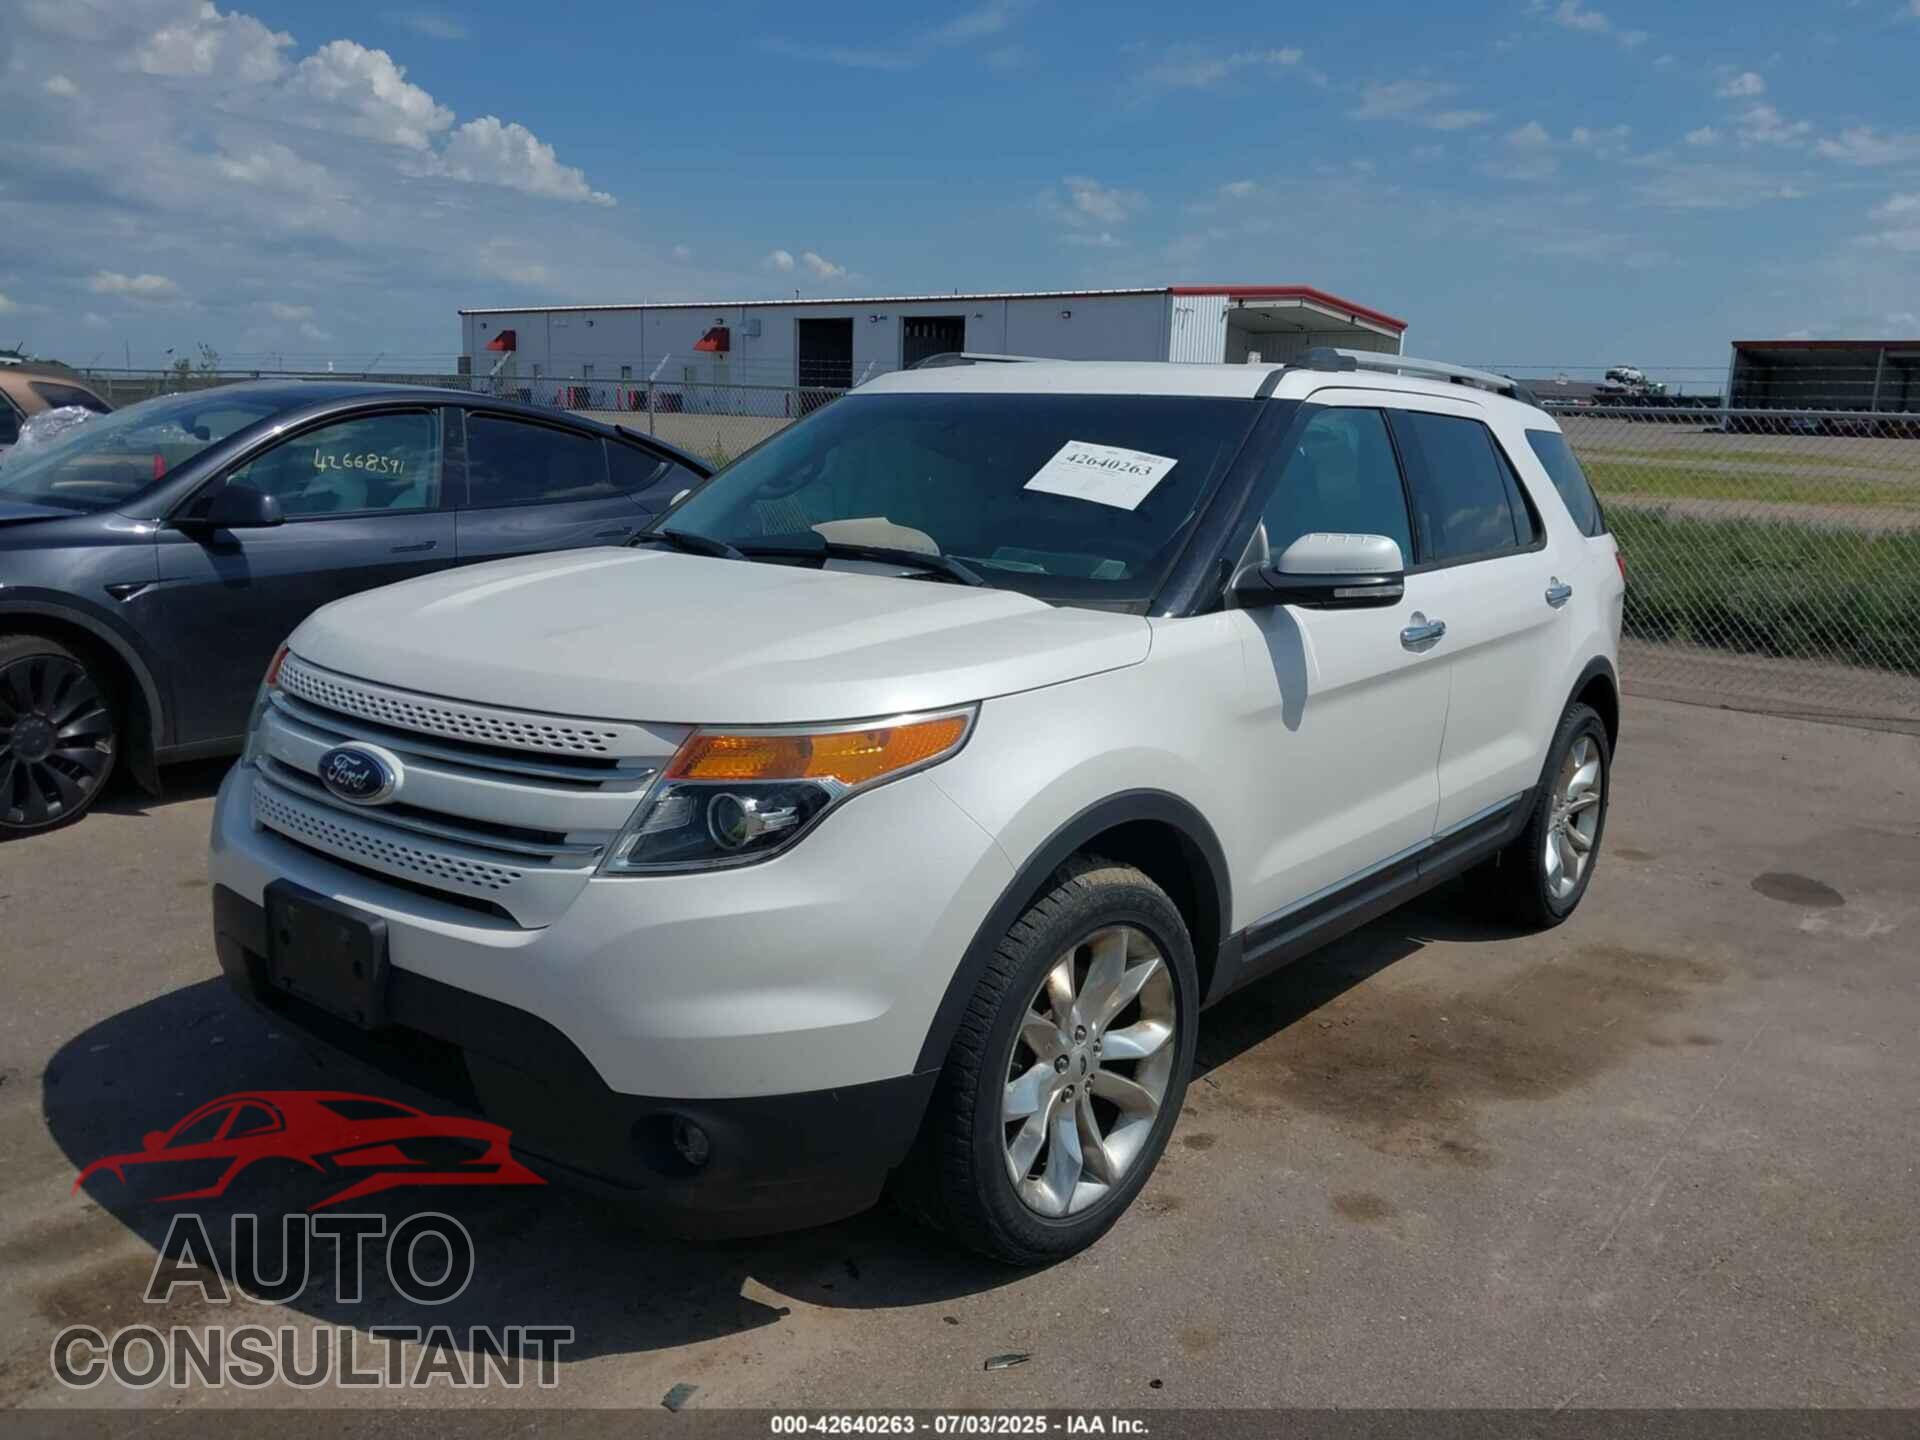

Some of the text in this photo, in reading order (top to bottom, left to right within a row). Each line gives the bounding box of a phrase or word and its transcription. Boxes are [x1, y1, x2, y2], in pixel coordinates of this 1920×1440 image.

[313, 447, 405, 475] 42668591
[1066, 453, 1153, 477] 42640263
[327, 754, 370, 788] Ford
